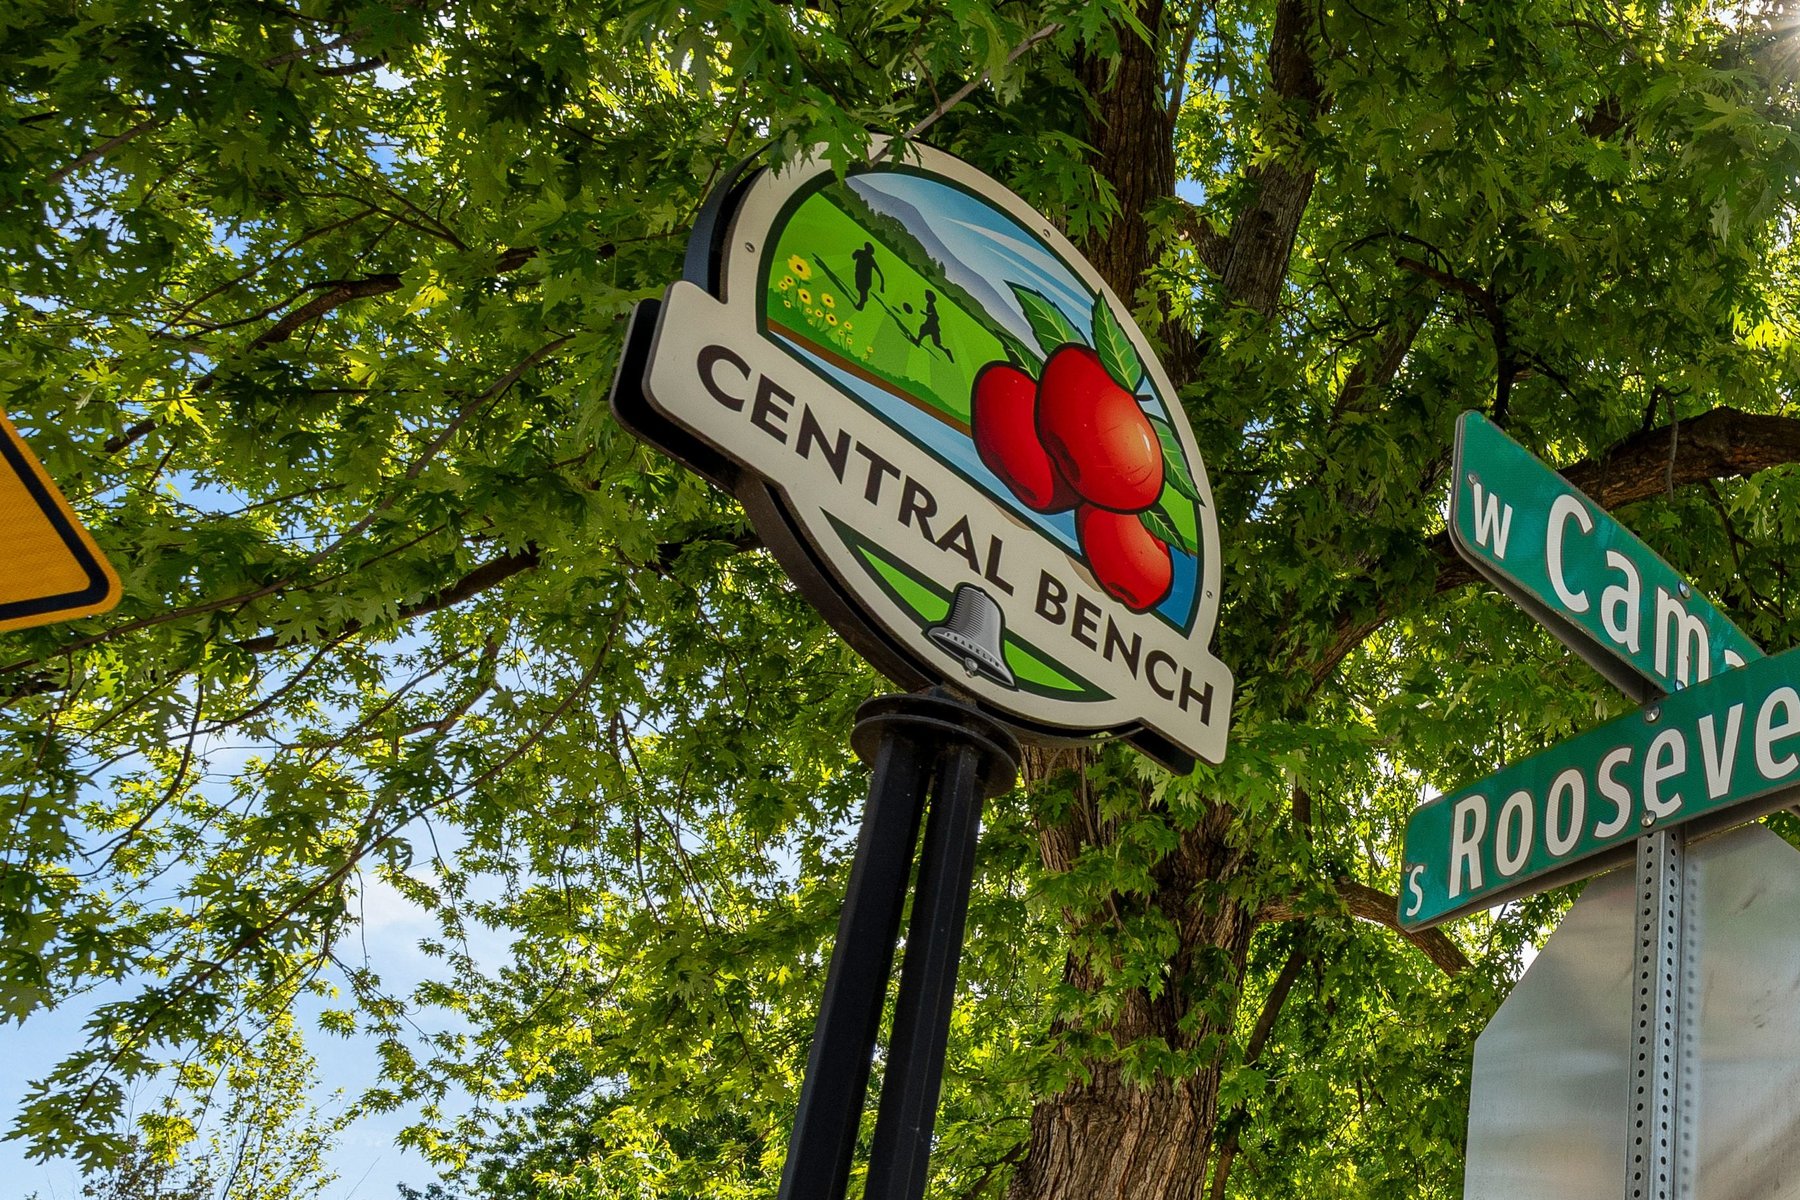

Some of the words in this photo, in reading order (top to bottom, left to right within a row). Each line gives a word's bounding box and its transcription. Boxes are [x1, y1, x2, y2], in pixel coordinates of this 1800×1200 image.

[697, 344, 1014, 597] CENTRAL
[1036, 568, 1212, 726] BENCH
[1470, 480, 1513, 559] W
[1545, 493, 1747, 687] Cam
[1406, 864, 1424, 918] S
